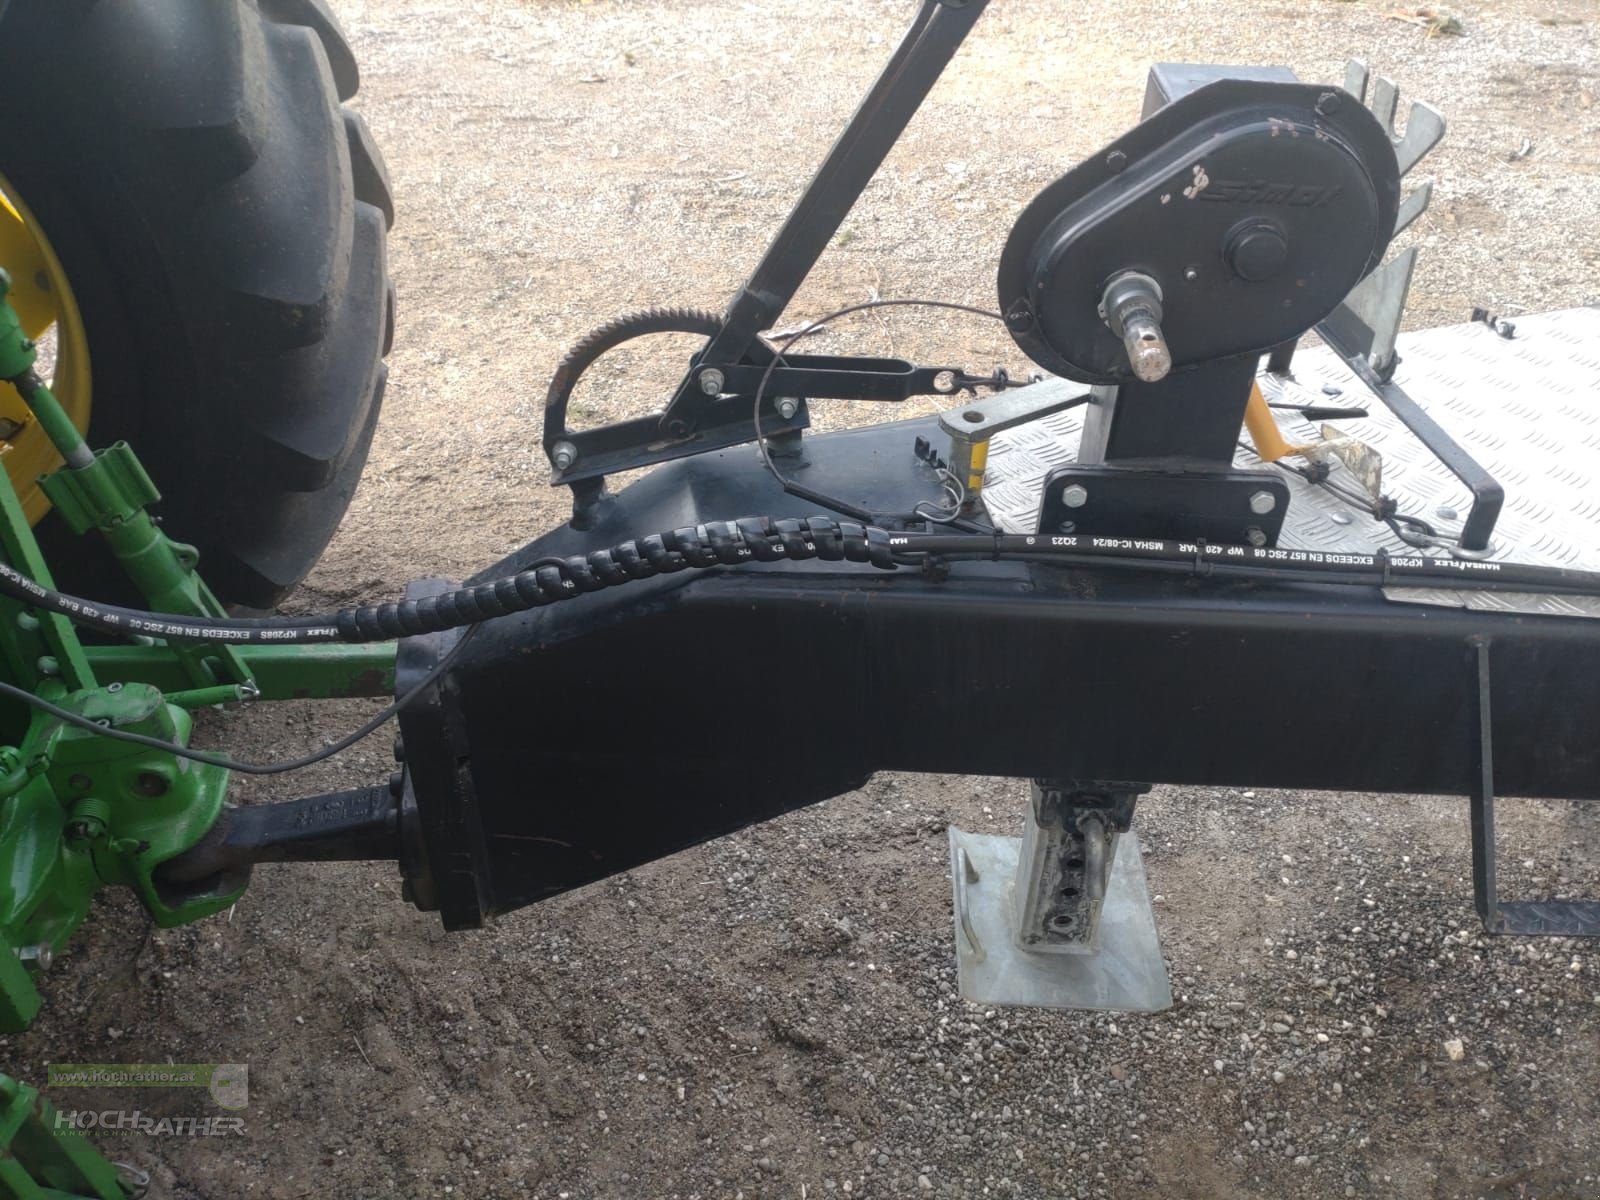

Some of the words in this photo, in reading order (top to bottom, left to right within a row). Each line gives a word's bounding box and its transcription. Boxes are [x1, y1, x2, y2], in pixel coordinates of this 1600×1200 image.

[1052, 537, 1077, 545] 2Q23
[1093, 538, 1132, 548] IC-08/24
[1134, 540, 1163, 550] MSHA
[1206, 545, 1222, 554] 420
[1227, 547, 1244, 556] WP
[1254, 549, 1265, 557] 08
[1268, 550, 1287, 558] 2SC
[1290, 551, 1306, 560] 857
[1309, 553, 1323, 562] EN
[1326, 554, 1374, 565] EXCEEDS
[58, 597, 79, 611] BAR
[82, 606, 99, 618] 420
[103, 613, 119, 624] WP
[144, 622, 163, 632] 2SC
[165, 625, 183, 635] 857
[185, 627, 200, 637] EN
[202, 629, 250, 639] EXCEEDS
[260, 630, 296, 639] KP208S
